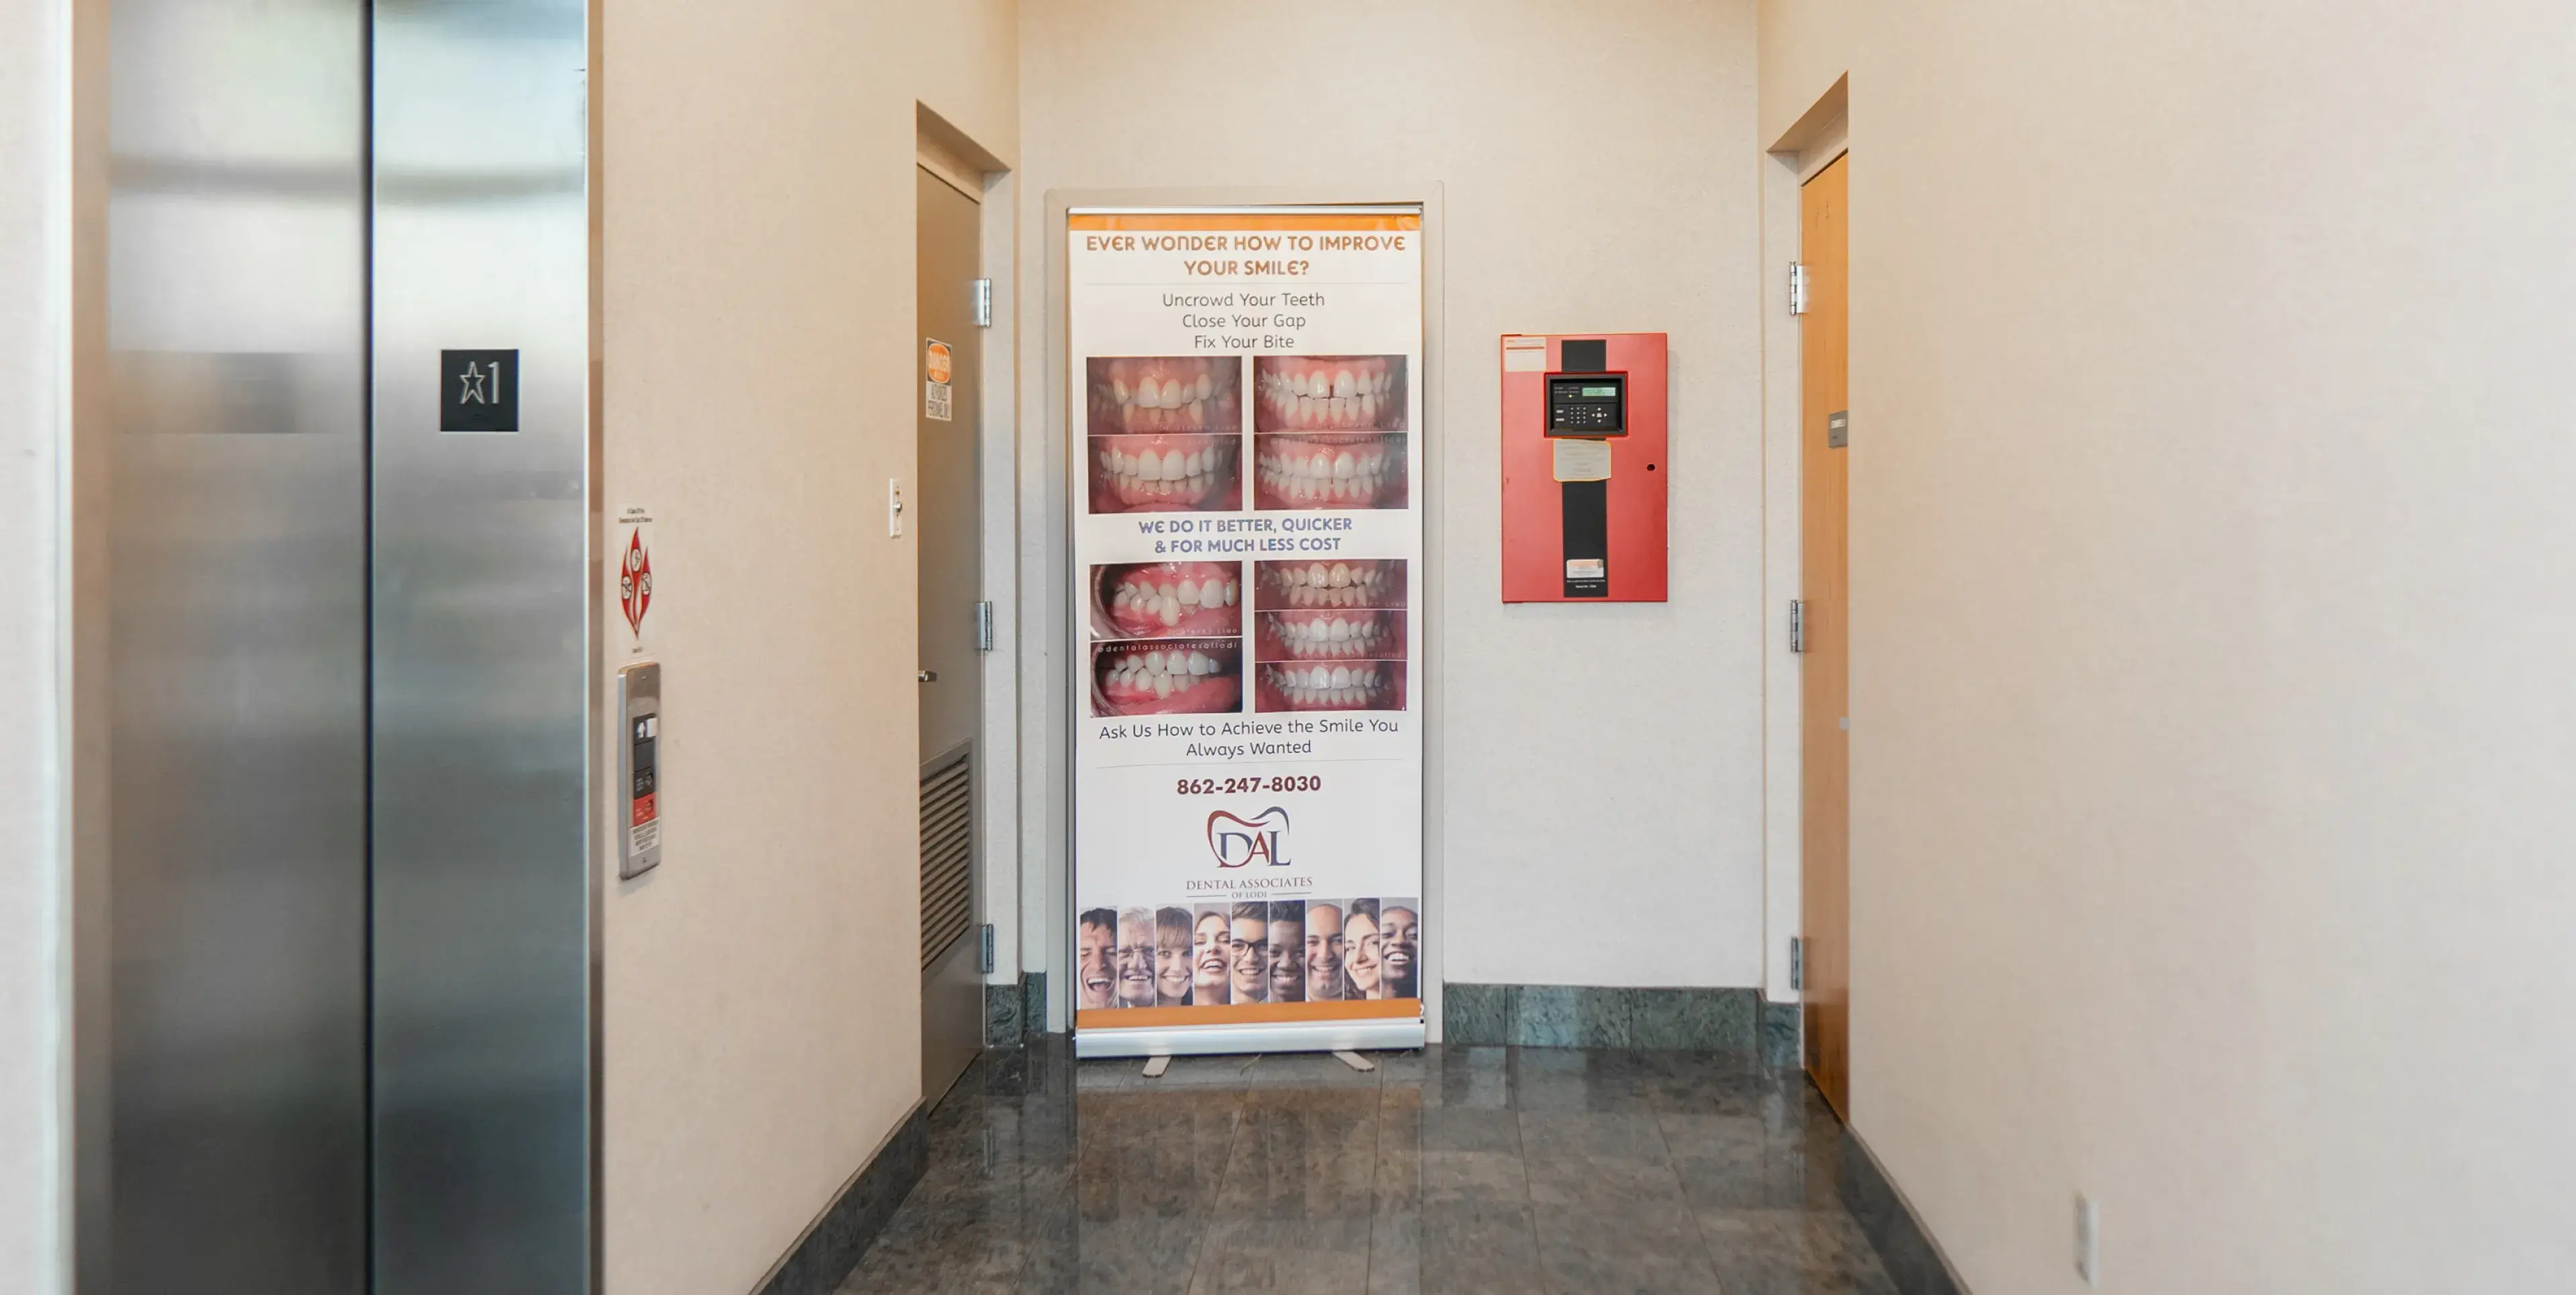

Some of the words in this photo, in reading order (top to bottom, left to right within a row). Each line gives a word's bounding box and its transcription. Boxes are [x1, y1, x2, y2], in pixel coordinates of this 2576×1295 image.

[1086, 235, 1136, 252] EVER
[1141, 235, 1228, 252] WONDER
[1234, 235, 1282, 251] HOW
[1287, 236, 1313, 252] TO
[1320, 235, 1405, 252] IMPROVE
[1183, 260, 1238, 276] YOUR
[1244, 260, 1309, 276] SMILE?
[1163, 292, 1234, 308] Uncrowd
[1239, 293, 1276, 307] Your
[1281, 292, 1325, 307] Teeth
[1183, 313, 1226, 328] Close
[1231, 314, 1268, 328] Your
[1273, 313, 1306, 333] Gap
[1195, 335, 1216, 349] Fix
[1221, 335, 1258, 349] Your
[1264, 334, 1294, 348] Bite
[487, 361, 499, 404] 1
[1138, 520, 1165, 534] WE
[1169, 519, 1194, 533] DO
[1199, 519, 1212, 533] IT
[1217, 518, 1277, 534] BETTER,
[1281, 517, 1352, 533] QUICKER
[1155, 540, 1167, 554] &
[1171, 539, 1203, 553] FOR
[1208, 539, 1254, 553] MUCH
[1259, 537, 1295, 552] LESS
[1299, 537, 1341, 552] COST
[1099, 725, 1128, 740] Ask
[1132, 724, 1152, 738] Us
[1158, 723, 1194, 737] How
[1198, 723, 1216, 737] to
[1221, 721, 1283, 736] Achieve
[1287, 719, 1313, 733] the
[1319, 718, 1364, 733] Smile
[1368, 715, 1399, 732] You
[1186, 742, 1244, 760] Always
[1249, 739, 1312, 756] Wanted
[1177, 775, 1322, 795] 862-247-8030
[1216, 830, 1292, 868] DAL
[1186, 880, 1237, 890] DENTAL
[1239, 876, 1313, 889] ASSOCIATES
